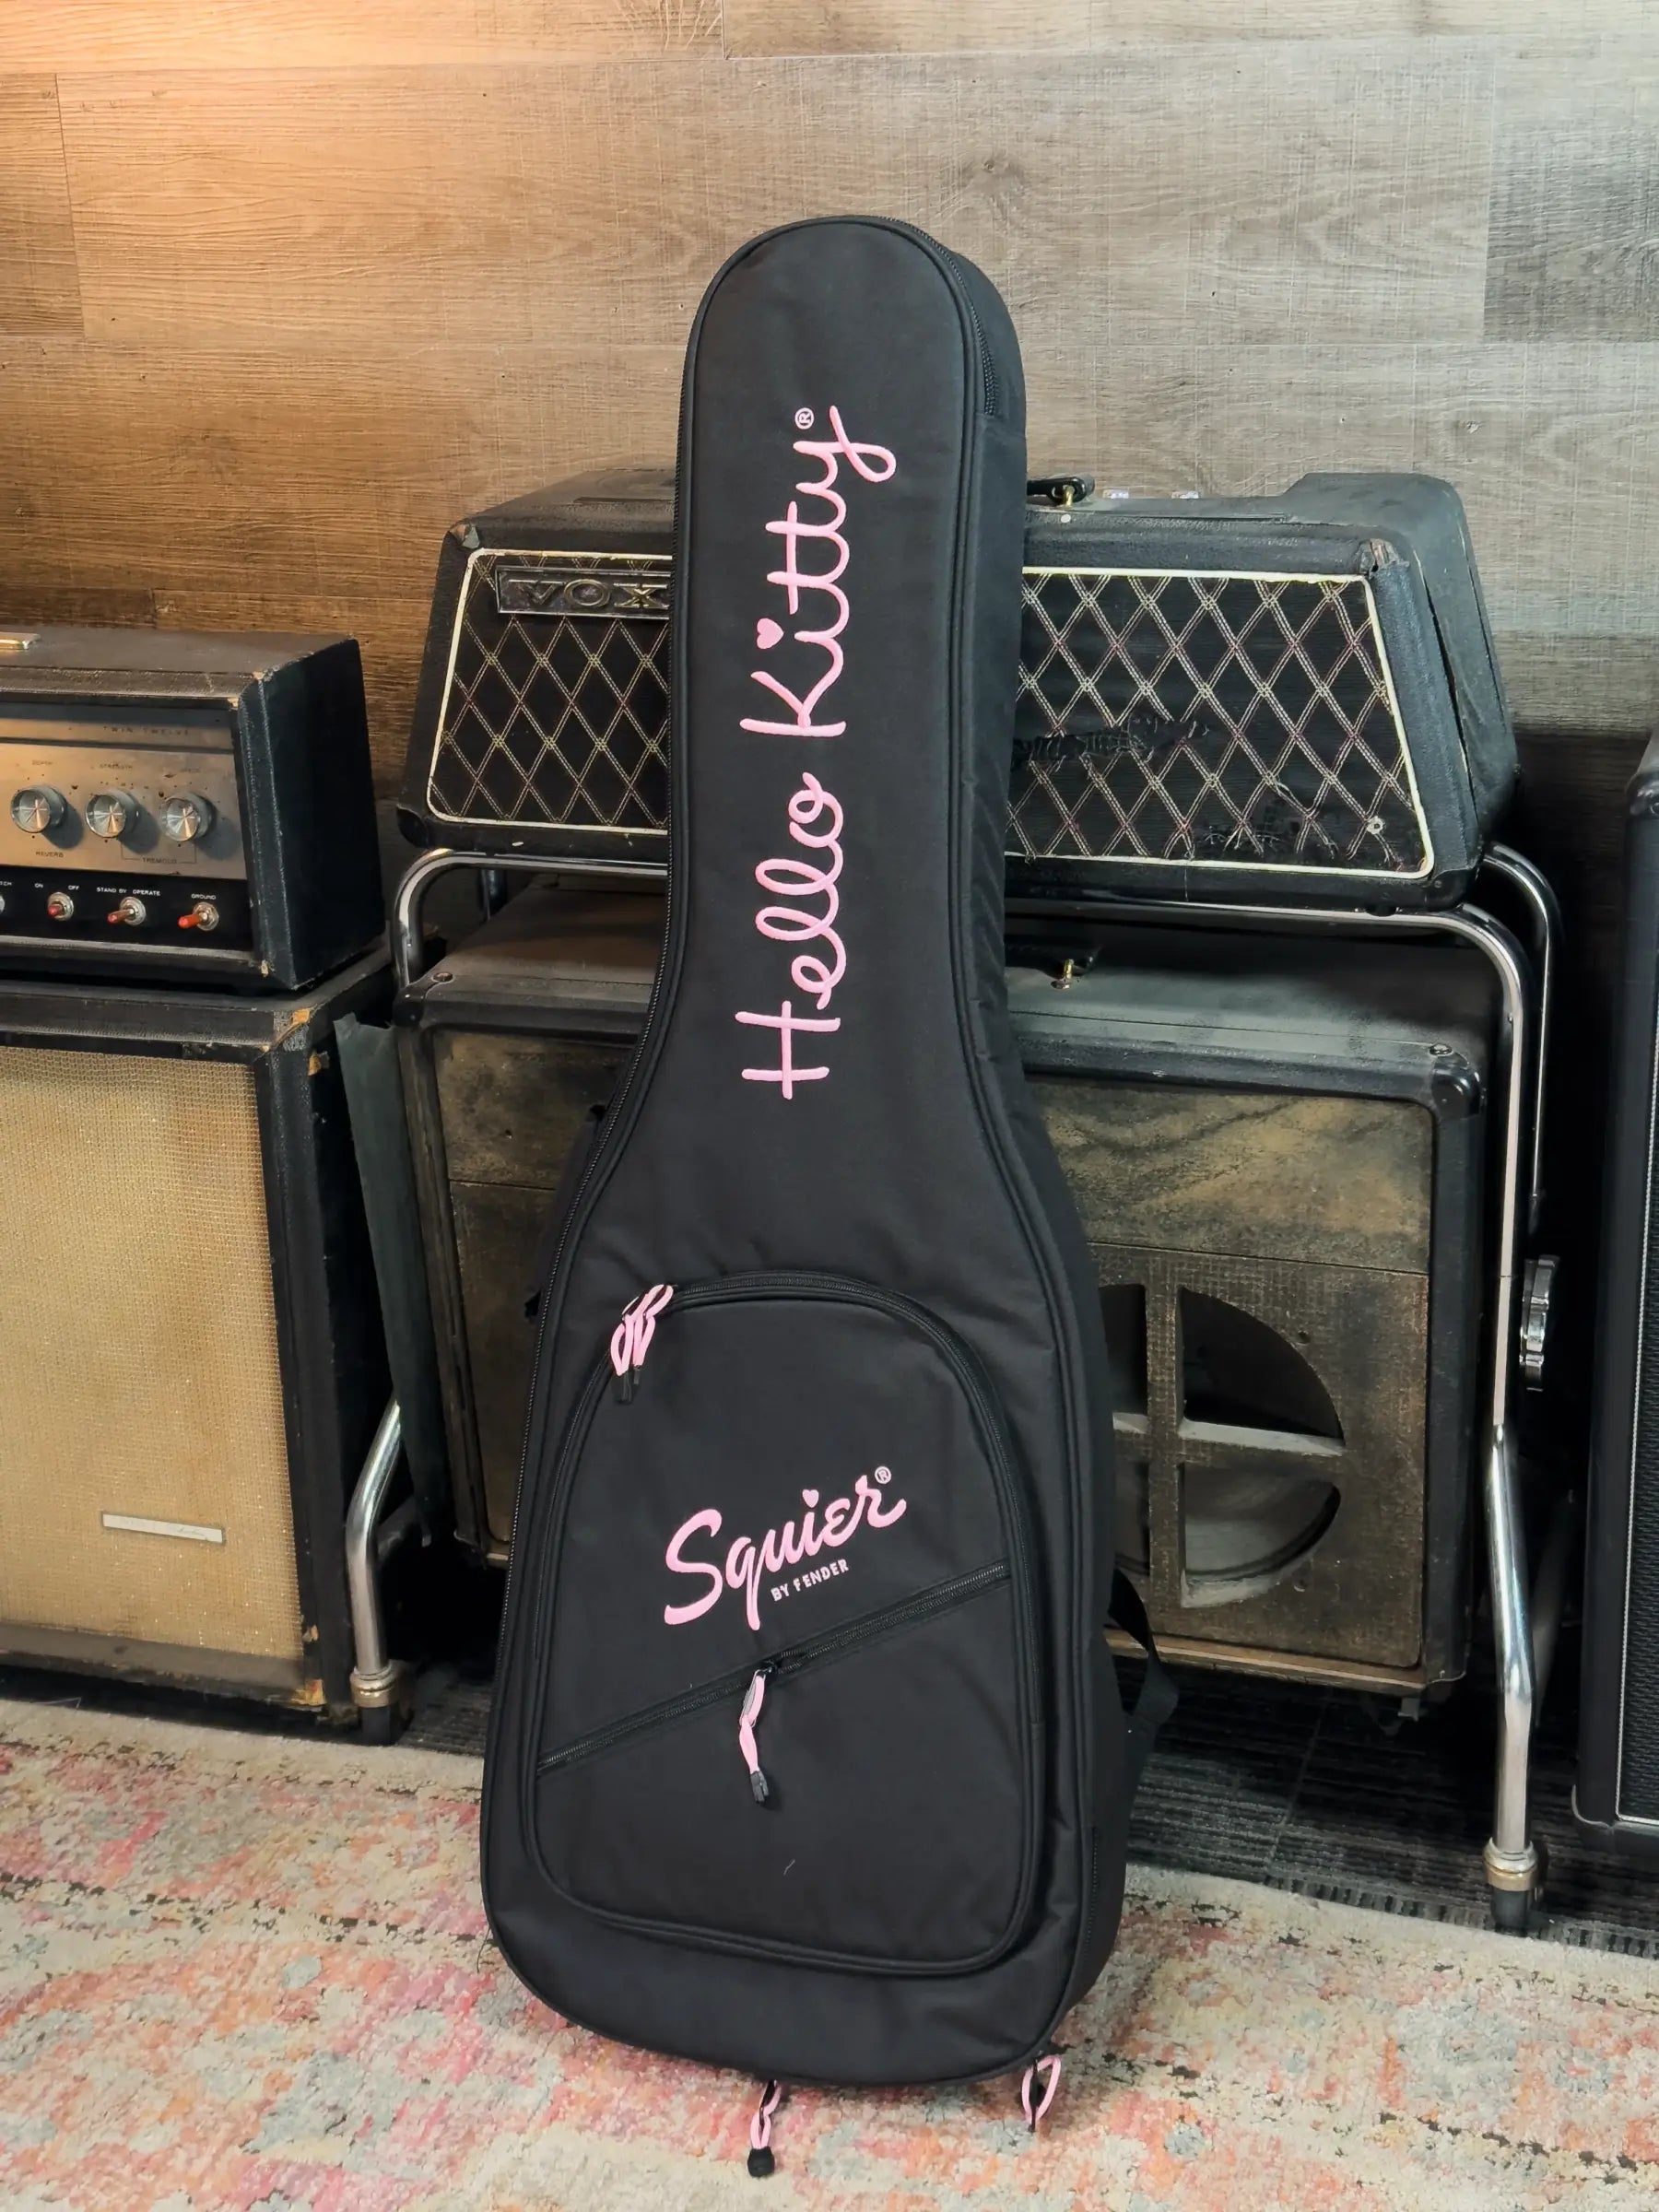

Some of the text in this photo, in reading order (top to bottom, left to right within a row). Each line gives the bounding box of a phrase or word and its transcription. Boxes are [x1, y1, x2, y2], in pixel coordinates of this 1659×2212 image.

[508, 577, 669, 611] VOX
[35, 851, 65, 859] REVERB
[132, 888, 161, 897] OPERATE
[735, 771, 847, 1100] Hello
[771, 1559, 850, 1602] BY FENDER
